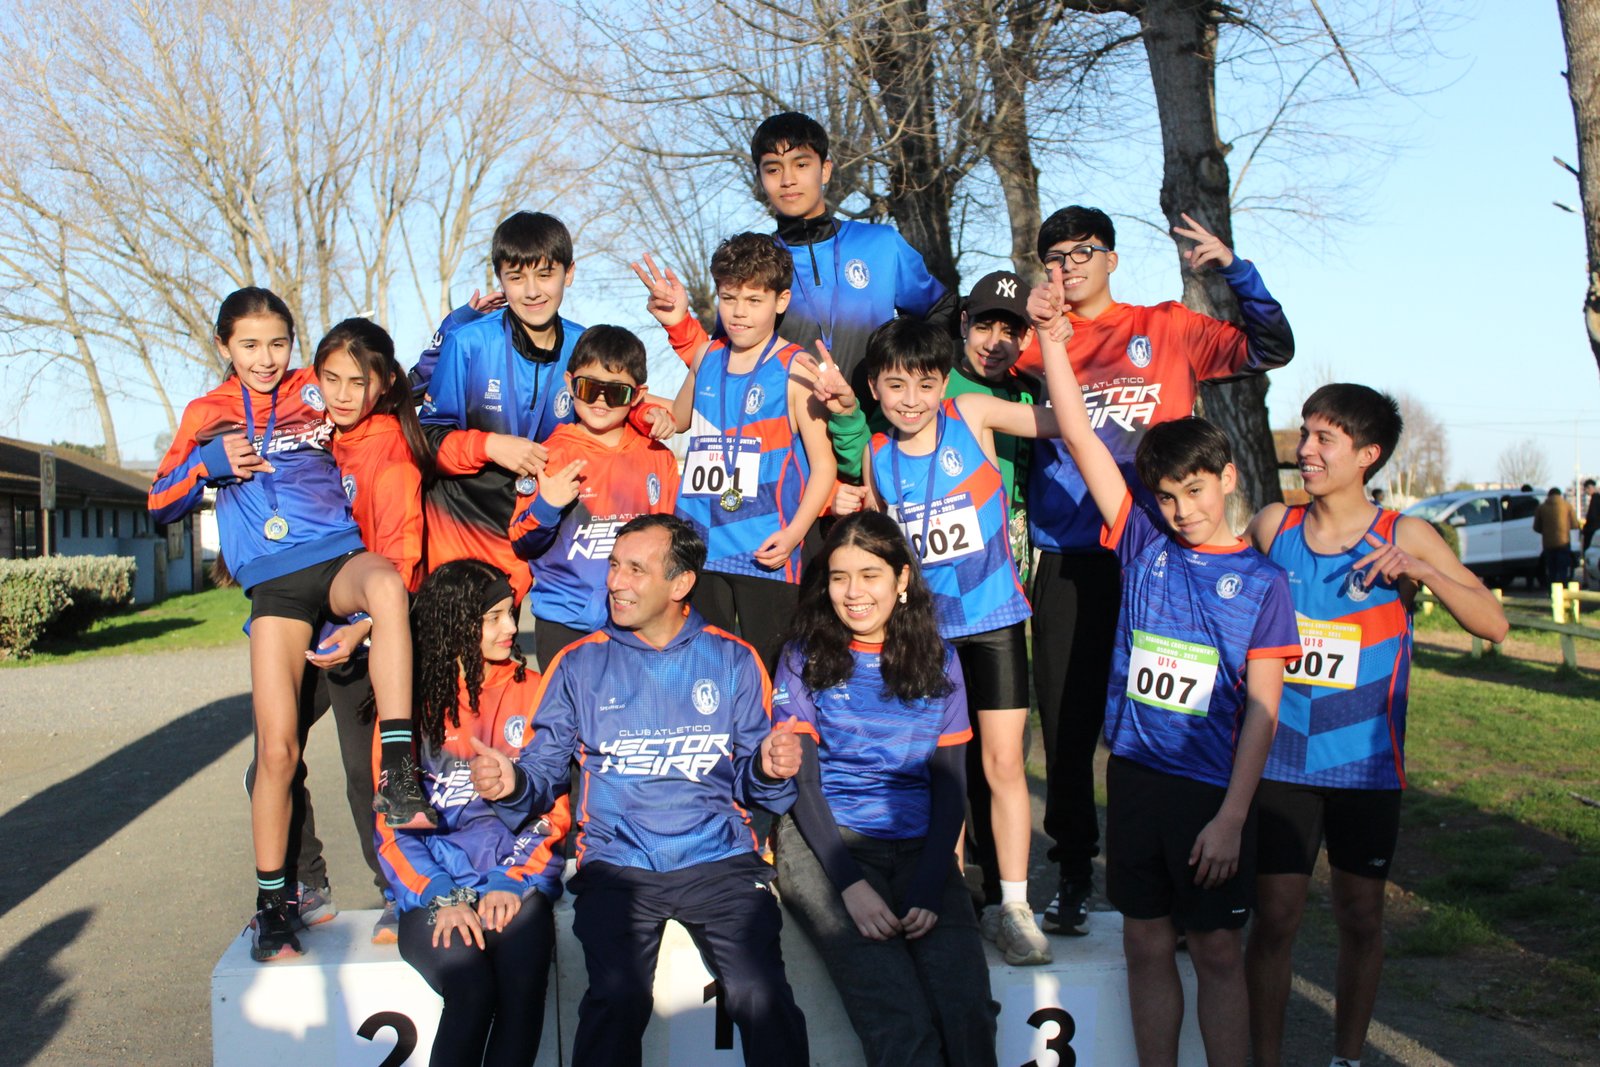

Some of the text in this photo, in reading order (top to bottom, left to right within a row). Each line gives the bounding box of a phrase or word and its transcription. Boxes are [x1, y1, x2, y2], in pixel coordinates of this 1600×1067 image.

[1083, 383, 1162, 405] CTOR
[1092, 376, 1145, 390] ATLETICO
[708, 452, 725, 462] U14
[691, 465, 744, 494] 001
[573, 522, 628, 540] HEC
[928, 517, 942, 528] 14
[911, 523, 970, 559] 002
[1304, 637, 1324, 648] U18
[1157, 656, 1178, 669] U16
[1284, 651, 1345, 680] 007
[1136, 667, 1198, 705] 007
[619, 724, 711, 737] CLUB ATLETICO
[599, 733, 730, 757] HECTOR
[598, 753, 722, 782] NEIRA
[703, 979, 734, 1050] 1
[356, 1011, 418, 1067] 2
[1020, 1007, 1077, 1067] 3
